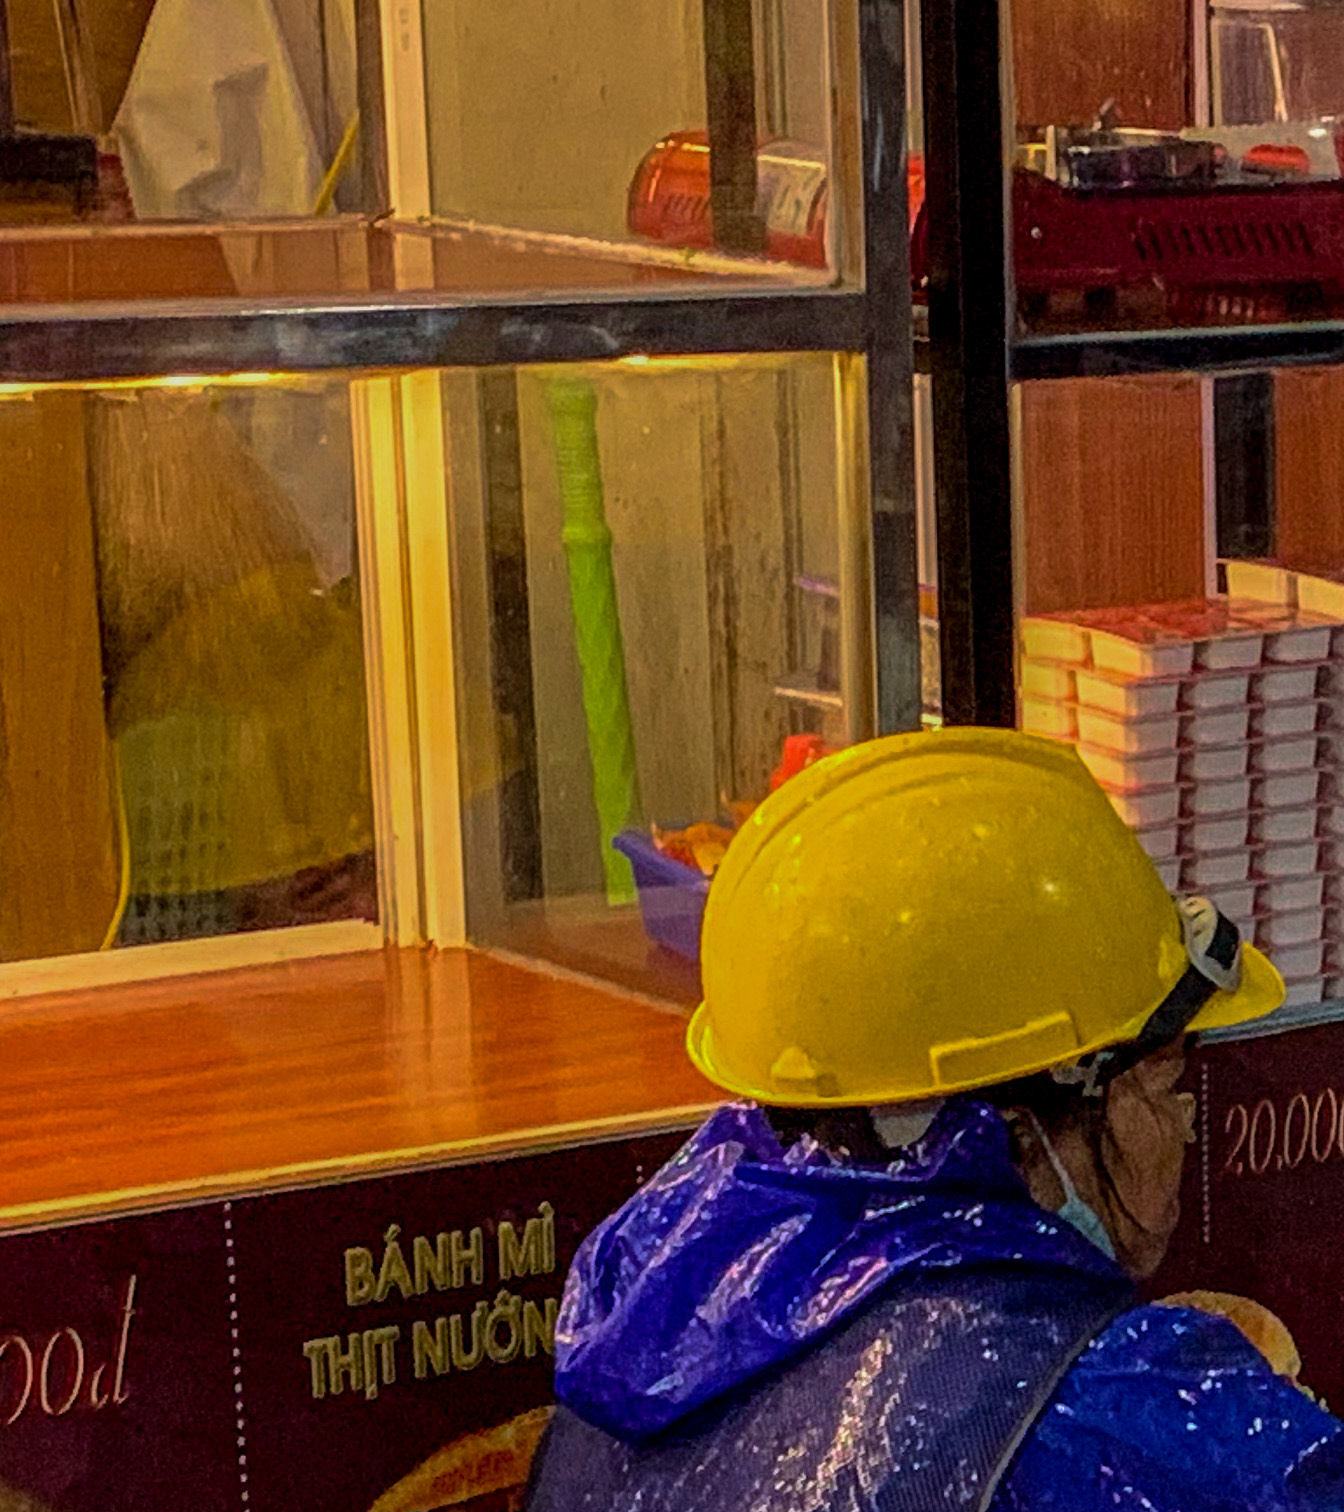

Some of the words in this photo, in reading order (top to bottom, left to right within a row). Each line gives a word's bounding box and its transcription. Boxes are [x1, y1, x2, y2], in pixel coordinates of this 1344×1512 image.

[344, 1223, 485, 1307] BÁNH
[303, 1324, 401, 1401] THỊT
[412, 1288, 560, 1379] NƯỚN
